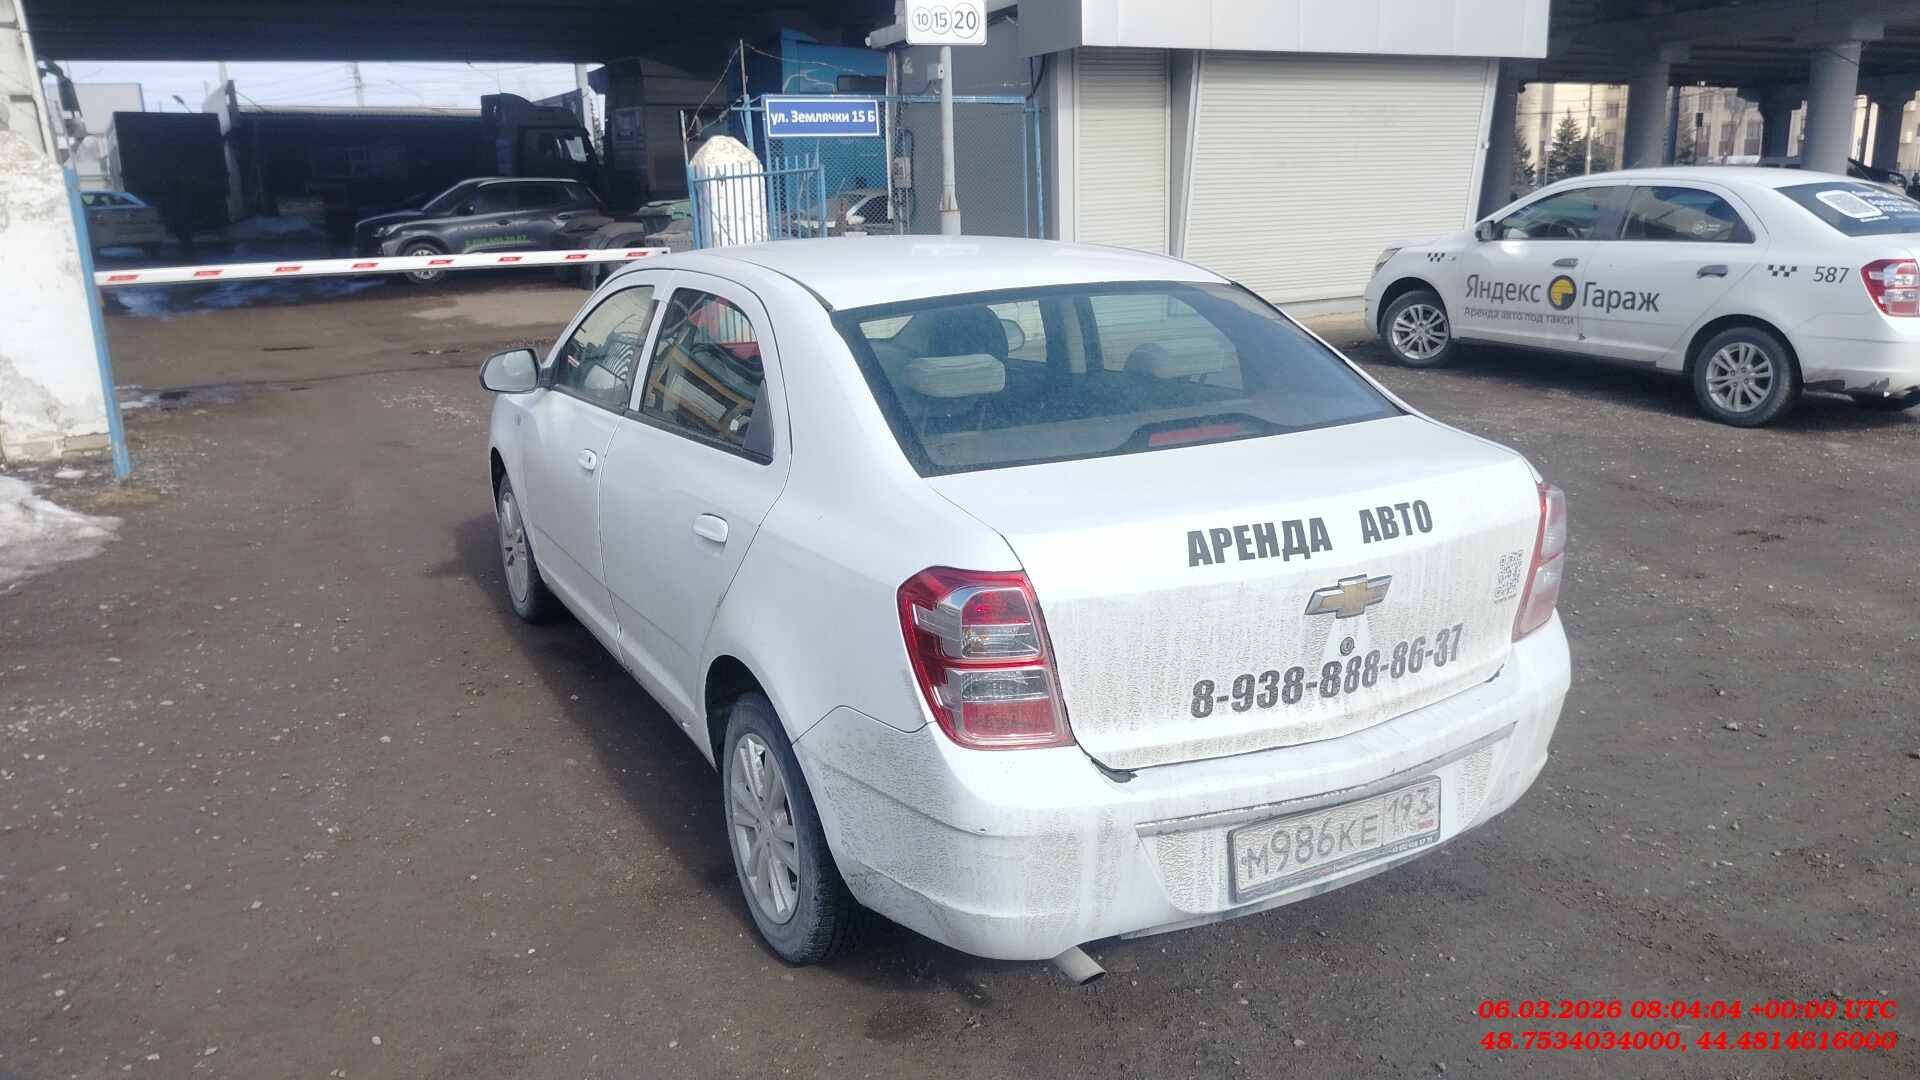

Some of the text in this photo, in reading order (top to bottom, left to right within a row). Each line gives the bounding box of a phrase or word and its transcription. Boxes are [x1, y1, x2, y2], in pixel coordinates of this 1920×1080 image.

[916, 10, 976, 30] 10 15 20
[770, 110, 876, 125] ул. Землячки 15 Б
[1812, 265, 1850, 284] 587
[1465, 274, 1660, 313] Яндекс Гараж
[1464, 306, 1575, 325] Аренда авто под такси
[1187, 500, 1433, 567] АРЕНДА АВТО
[1190, 623, 1464, 719] 8-938-888-86-37
